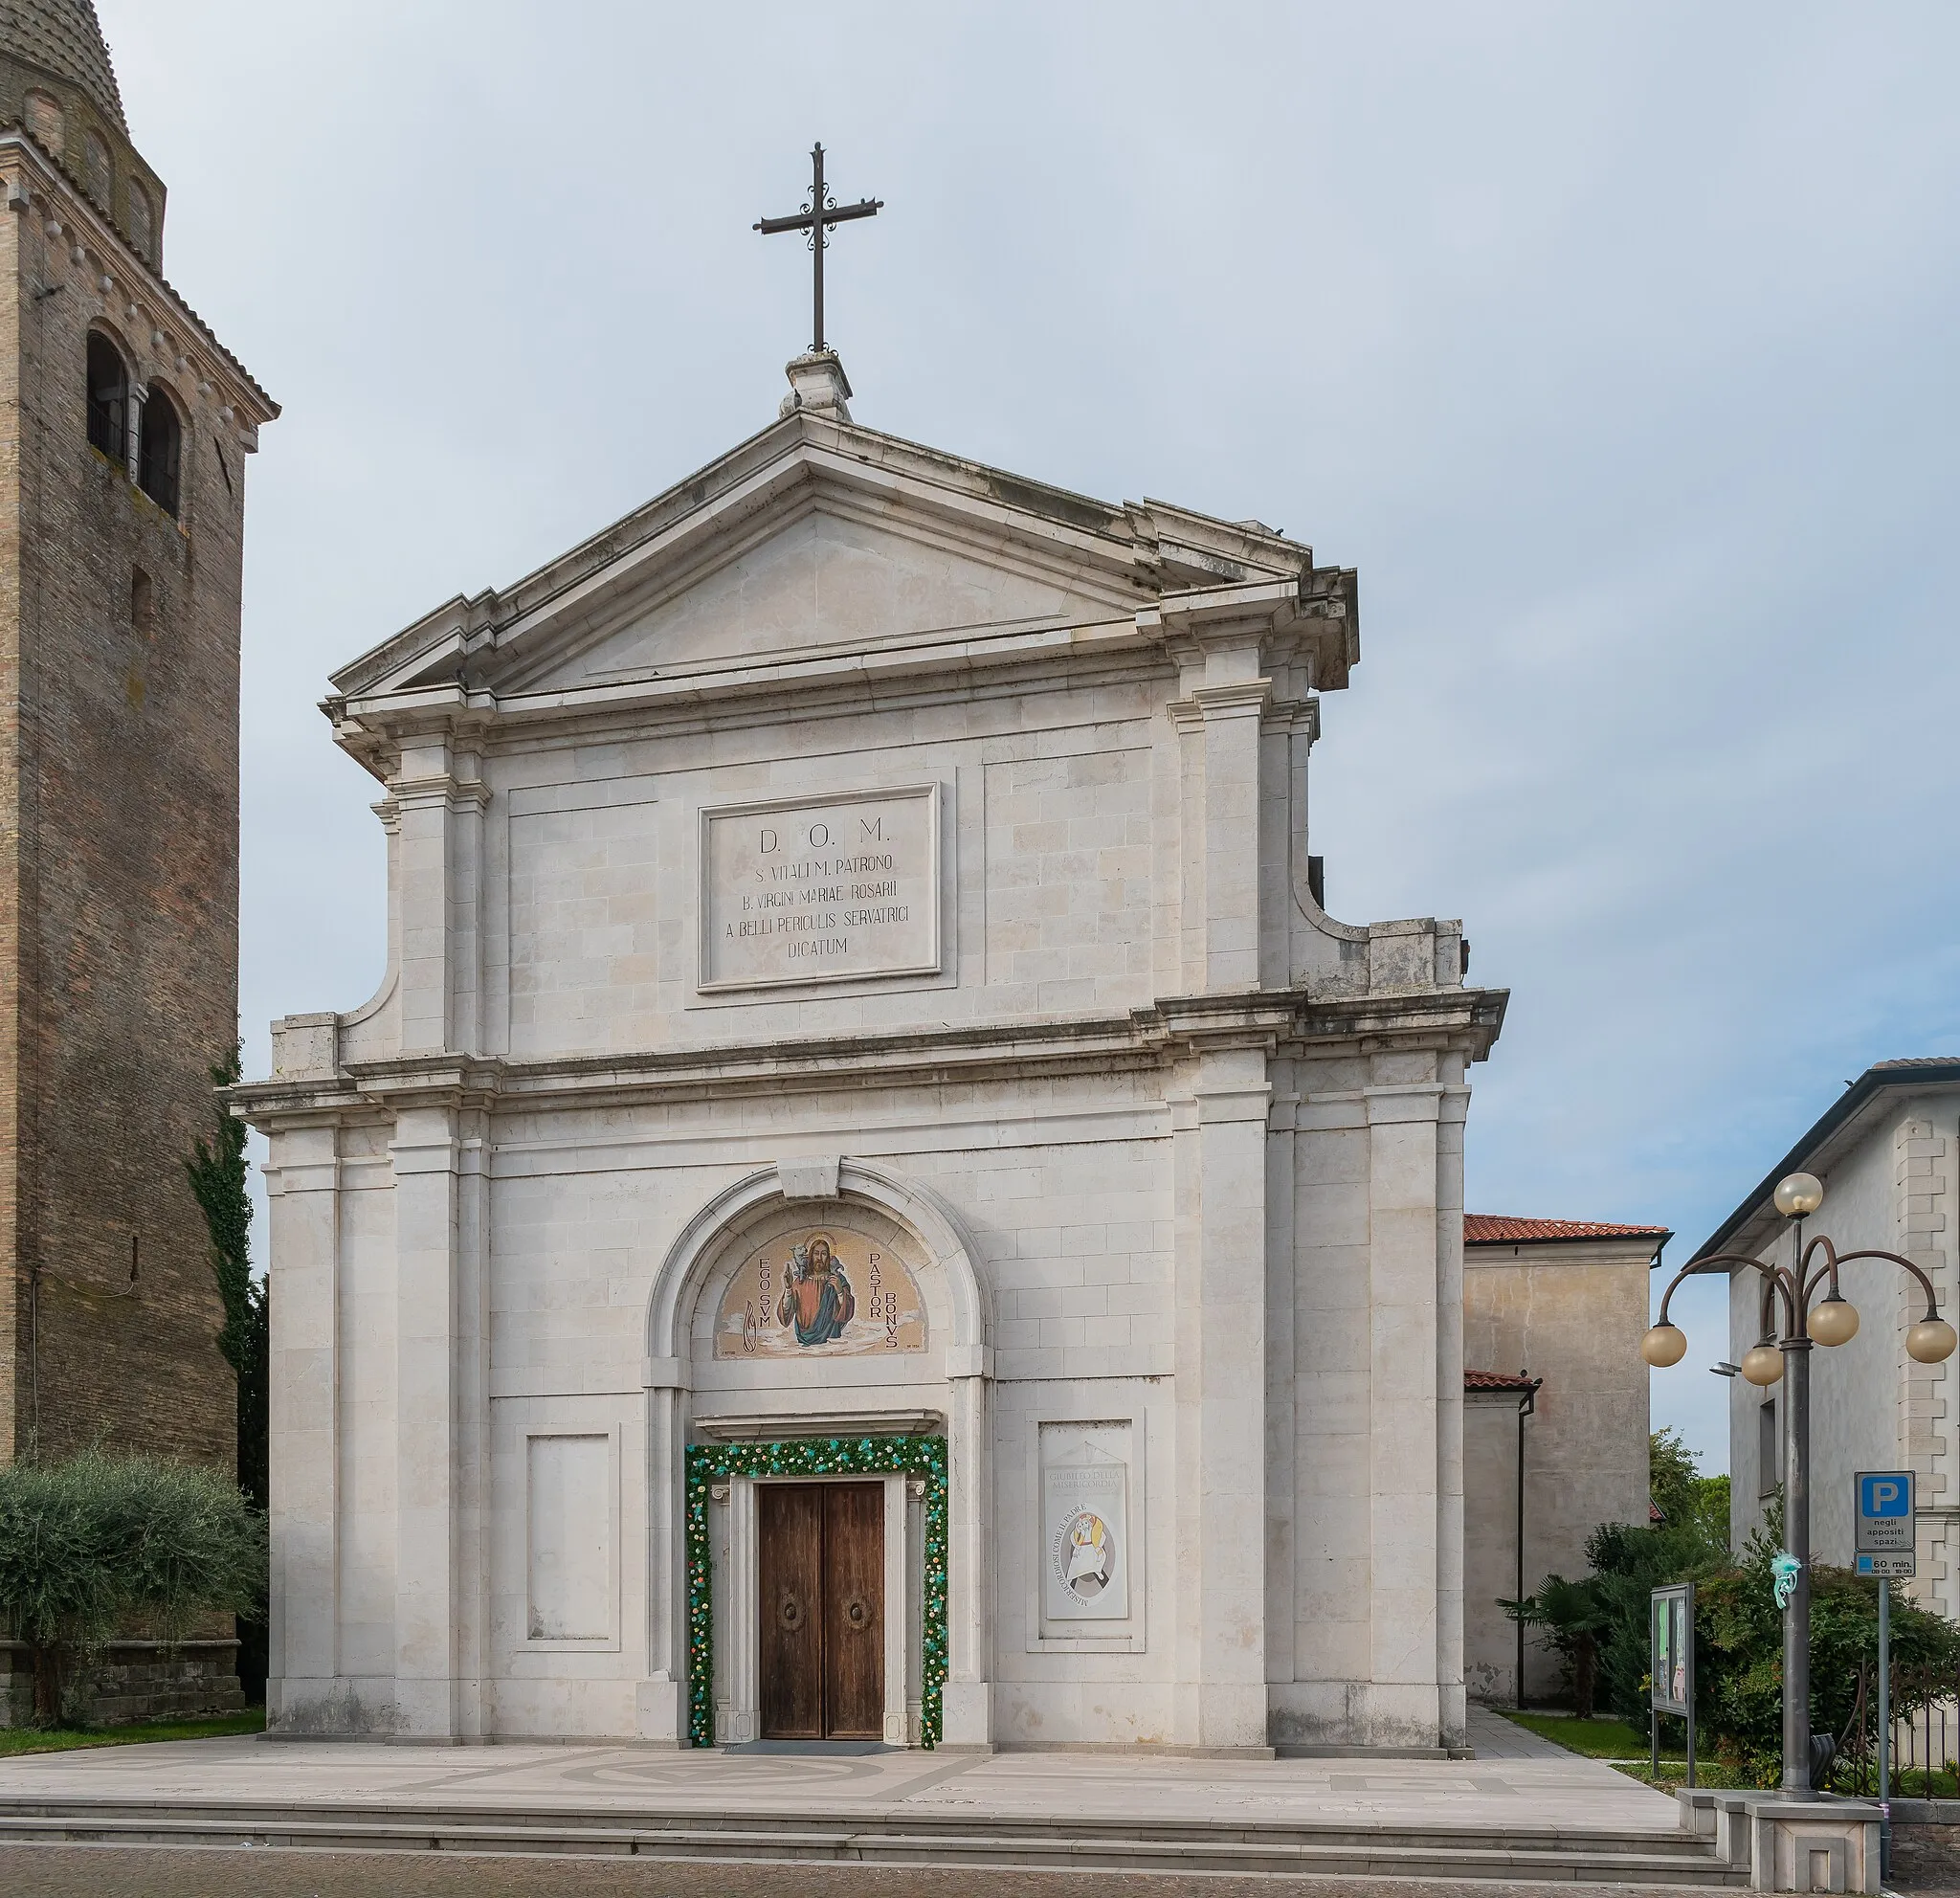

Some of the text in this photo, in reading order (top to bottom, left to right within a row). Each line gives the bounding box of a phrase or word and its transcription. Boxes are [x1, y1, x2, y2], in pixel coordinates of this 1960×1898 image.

[760, 816, 890, 854] D. O. M.
[755, 854, 893, 882] S. VITALI M. PATRONO
[743, 880, 897, 910] B. VIRGINI MARIAE ROSARII
[725, 905, 909, 938] A BELLI PERICULIS SERVATRICI
[788, 937, 848, 958] DICATUM
[869, 1253, 881, 1318] PASTOR
[885, 1292, 898, 1349] BONVS
[1053, 1479, 1118, 1489] MISERICORDIA
[1093, 1470, 1120, 1479] DELLA
[1873, 1483, 1899, 1511] P
[1063, 1503, 1087, 1524] PADRE
[1874, 1518, 1897, 1527] negli
[1053, 1530, 1063, 1553] COME
[1866, 1528, 1904, 1537] appositi
[1874, 1538, 1897, 1547] spazi
[1053, 1554, 1089, 1607] MISERICORDIOSI
